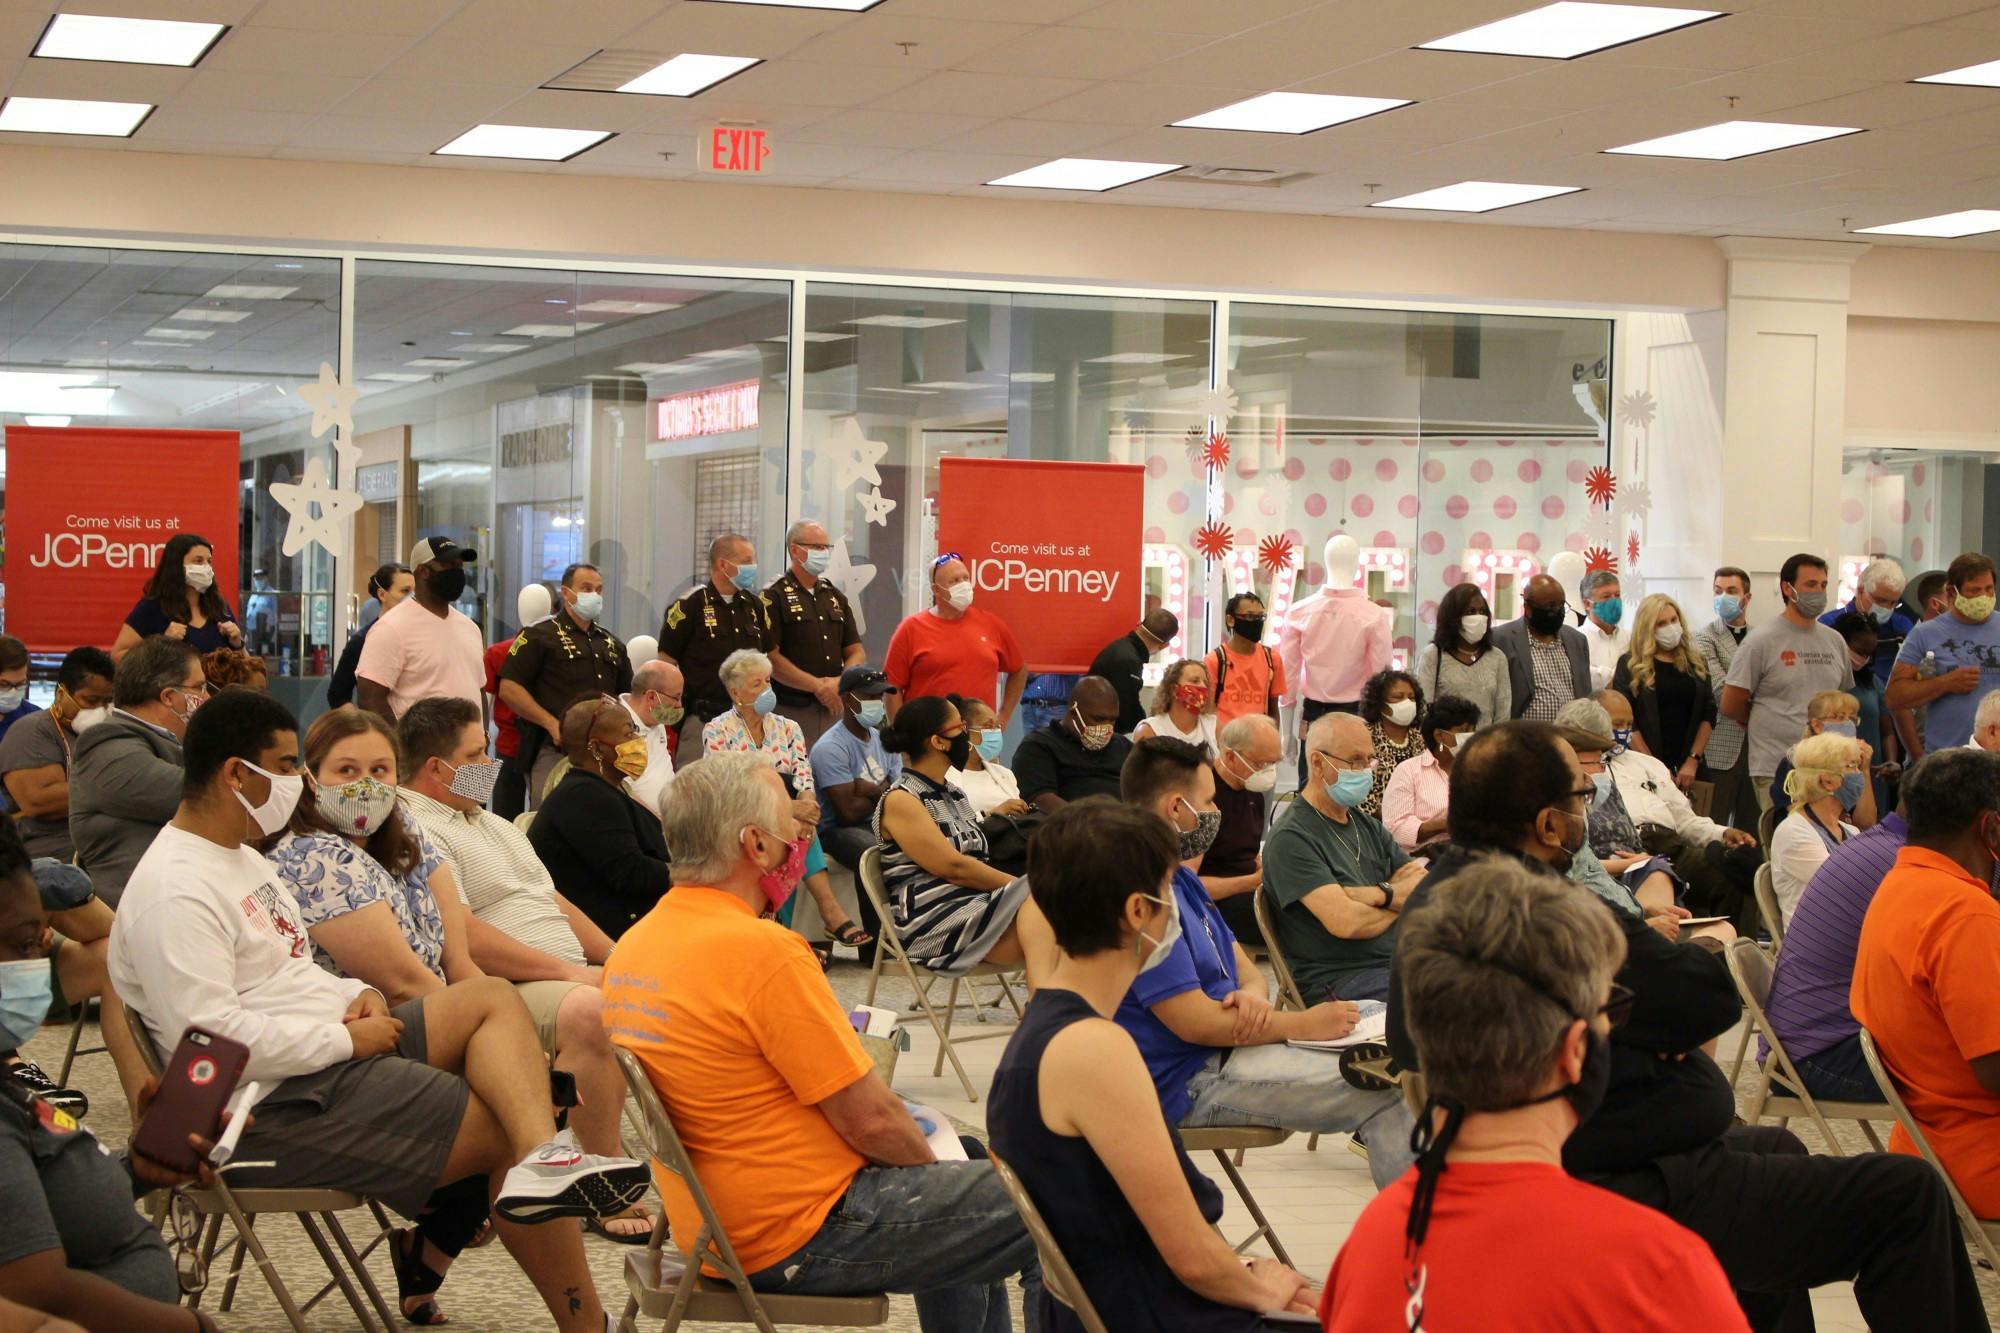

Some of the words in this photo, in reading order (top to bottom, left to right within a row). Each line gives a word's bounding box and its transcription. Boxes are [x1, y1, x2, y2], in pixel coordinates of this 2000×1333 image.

[712, 128, 765, 171] EXIT
[703, 388, 737, 434] SECRET
[66, 514, 110, 529] Come
[113, 515, 141, 529] visit
[145, 519, 161, 529] us
[165, 516, 180, 529] at
[30, 532, 167, 568] JCPenn
[990, 541, 1029, 555] Come
[1032, 542, 1057, 556] visit
[1060, 546, 1075, 556] us
[1077, 544, 1091, 557] at
